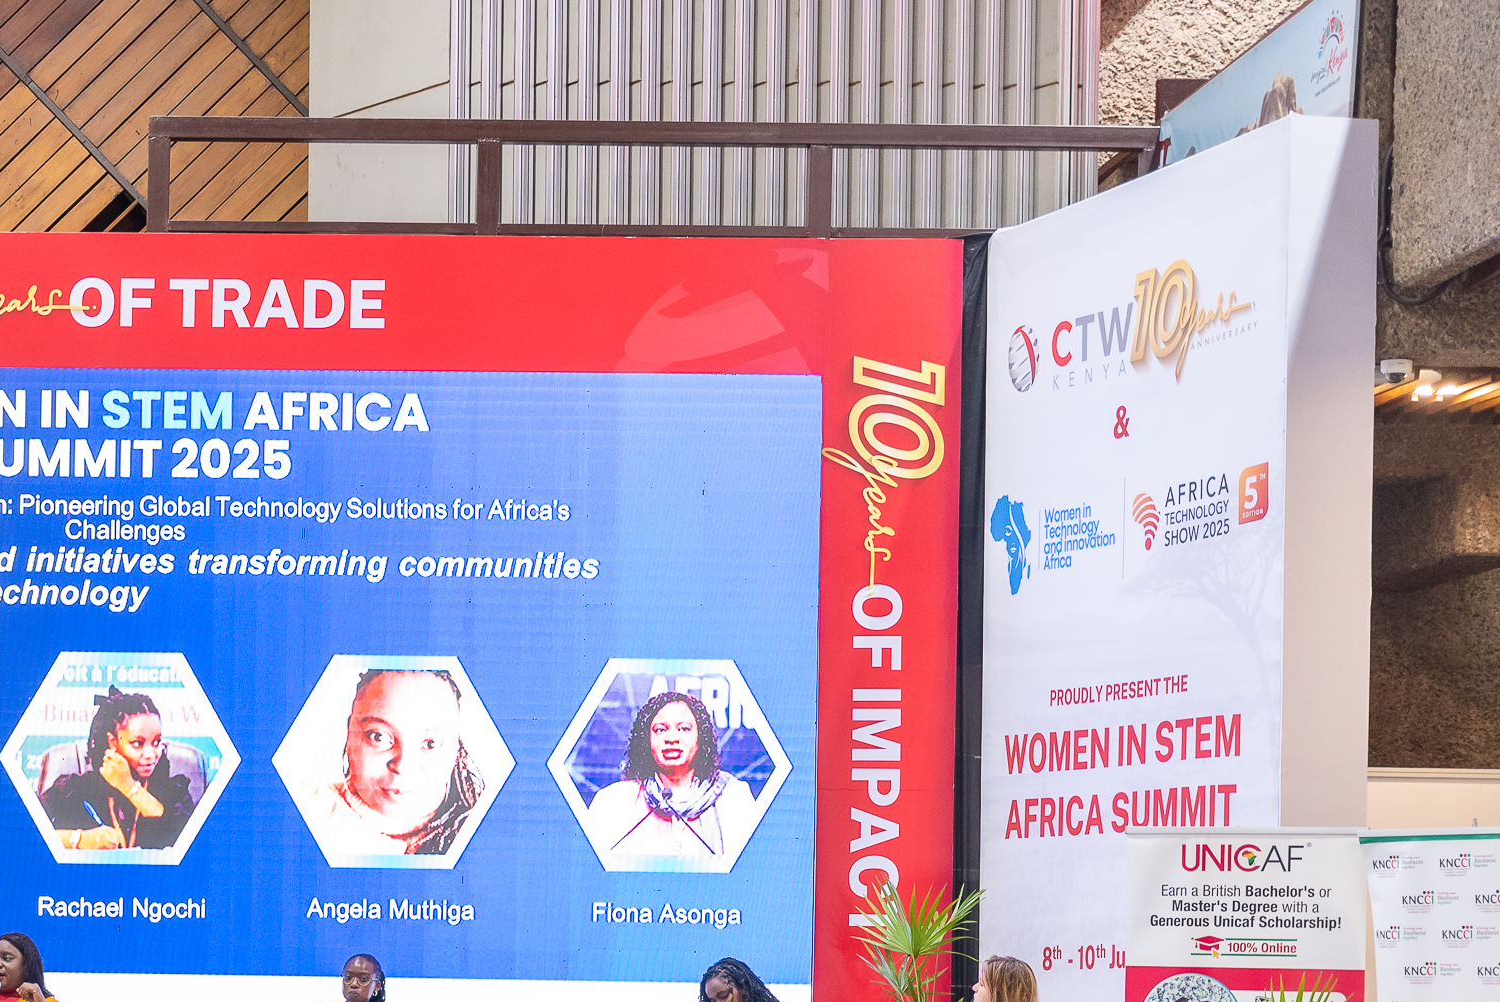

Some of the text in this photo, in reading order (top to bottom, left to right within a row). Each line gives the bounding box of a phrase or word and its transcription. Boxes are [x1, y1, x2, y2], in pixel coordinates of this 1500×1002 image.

[70, 277, 154, 329] OF
[170, 278, 387, 330] TRADE
[1052, 302, 1134, 367] CTW
[1130, 259, 1255, 381] 10 years
[1190, 321, 1259, 352] ANNIVERSARY
[1052, 360, 1127, 391] KENYA
[42, 389, 90, 429] IN
[102, 390, 232, 430] STEM
[244, 392, 430, 432] AFRICA
[848, 355, 946, 480] 10
[1113, 405, 1131, 440] &
[172, 439, 292, 480] 2025
[1164, 474, 1229, 508] AFRICA
[19, 494, 134, 521] Pioneering
[139, 496, 211, 517] Global
[216, 497, 342, 524] Technology
[347, 498, 448, 520] Solutions
[452, 499, 483, 520] for
[488, 499, 570, 521] Africa's
[822, 447, 899, 590] years
[1044, 503, 1091, 523] Women in
[1164, 499, 1229, 526] TECHNOLOGY
[1242, 508, 1264, 519] EDITION
[65, 520, 186, 545] Challenges
[1044, 516, 1100, 538] Technology
[1164, 518, 1230, 548] SHOW 2025
[1044, 531, 1116, 554] and innovation
[25, 548, 175, 575] initiatives
[188, 550, 388, 583] transforming
[399, 553, 600, 580] communities
[1043, 553, 1072, 571] Africa
[852, 583, 903, 671] OF
[1050, 674, 1188, 707] PROUDLY PRESENT THE
[1005, 713, 1242, 775] WOMEN IN STEM
[1005, 784, 1238, 840] AFRICA SUMMIT
[1181, 843, 1304, 872] UNICAF
[1161, 884, 1332, 898] Earn a British Bachelor's or
[37, 896, 207, 923] Rachael Ngochi
[306, 897, 476, 925] Angela Muthiga
[591, 902, 742, 930] Fiona Asonga
[1172, 900, 1319, 915] Master's Degree with a
[1150, 914, 1342, 932] Generous Unicaf Scholarship!
[1042, 944, 1106, 971] 8th 10th
[1227, 942, 1297, 954] 100% Online
